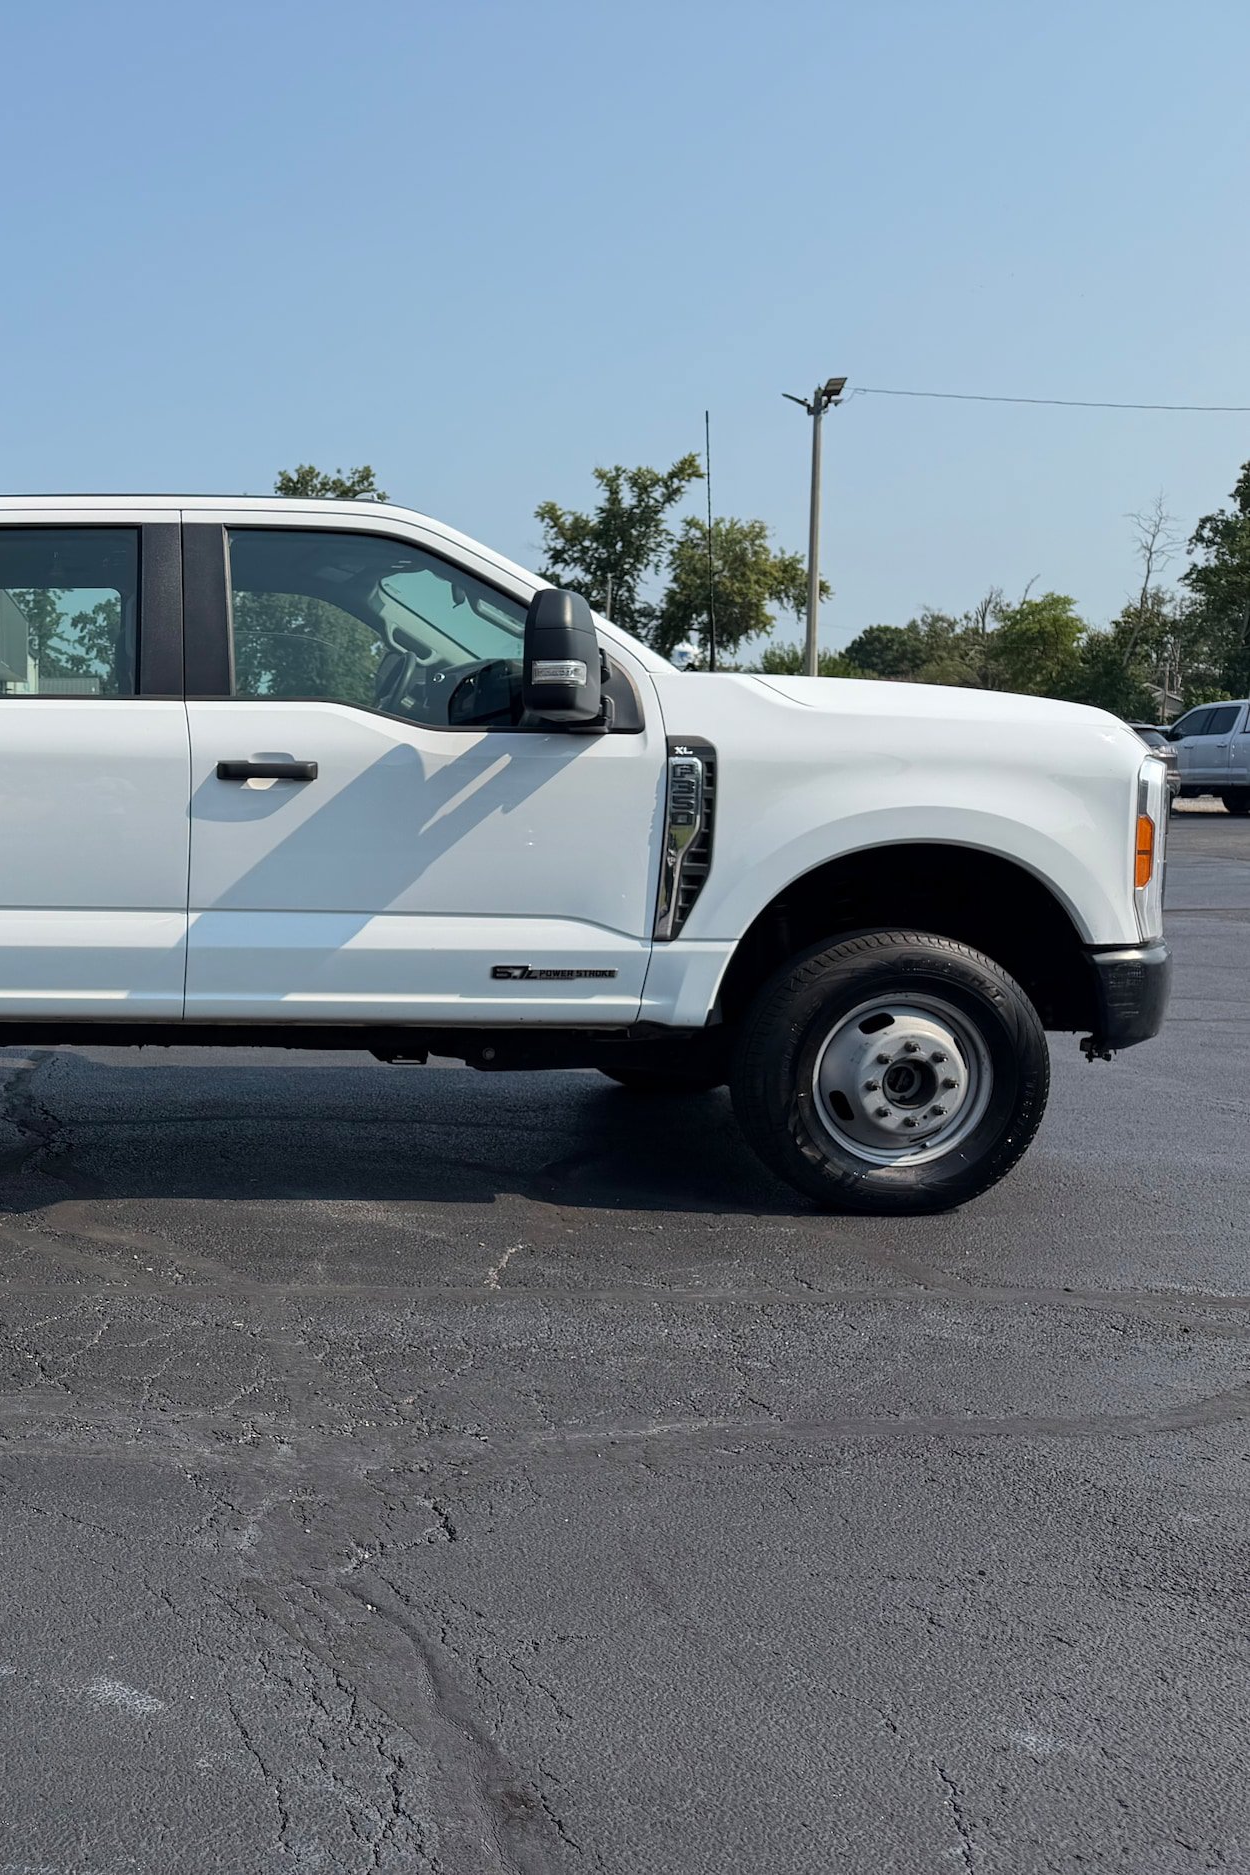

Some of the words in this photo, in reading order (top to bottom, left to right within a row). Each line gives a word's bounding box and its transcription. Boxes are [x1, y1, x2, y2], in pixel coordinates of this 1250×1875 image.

[674, 746, 693, 755] XL
[539, 969, 573, 979] POWER
[576, 969, 617, 979] STROKE
